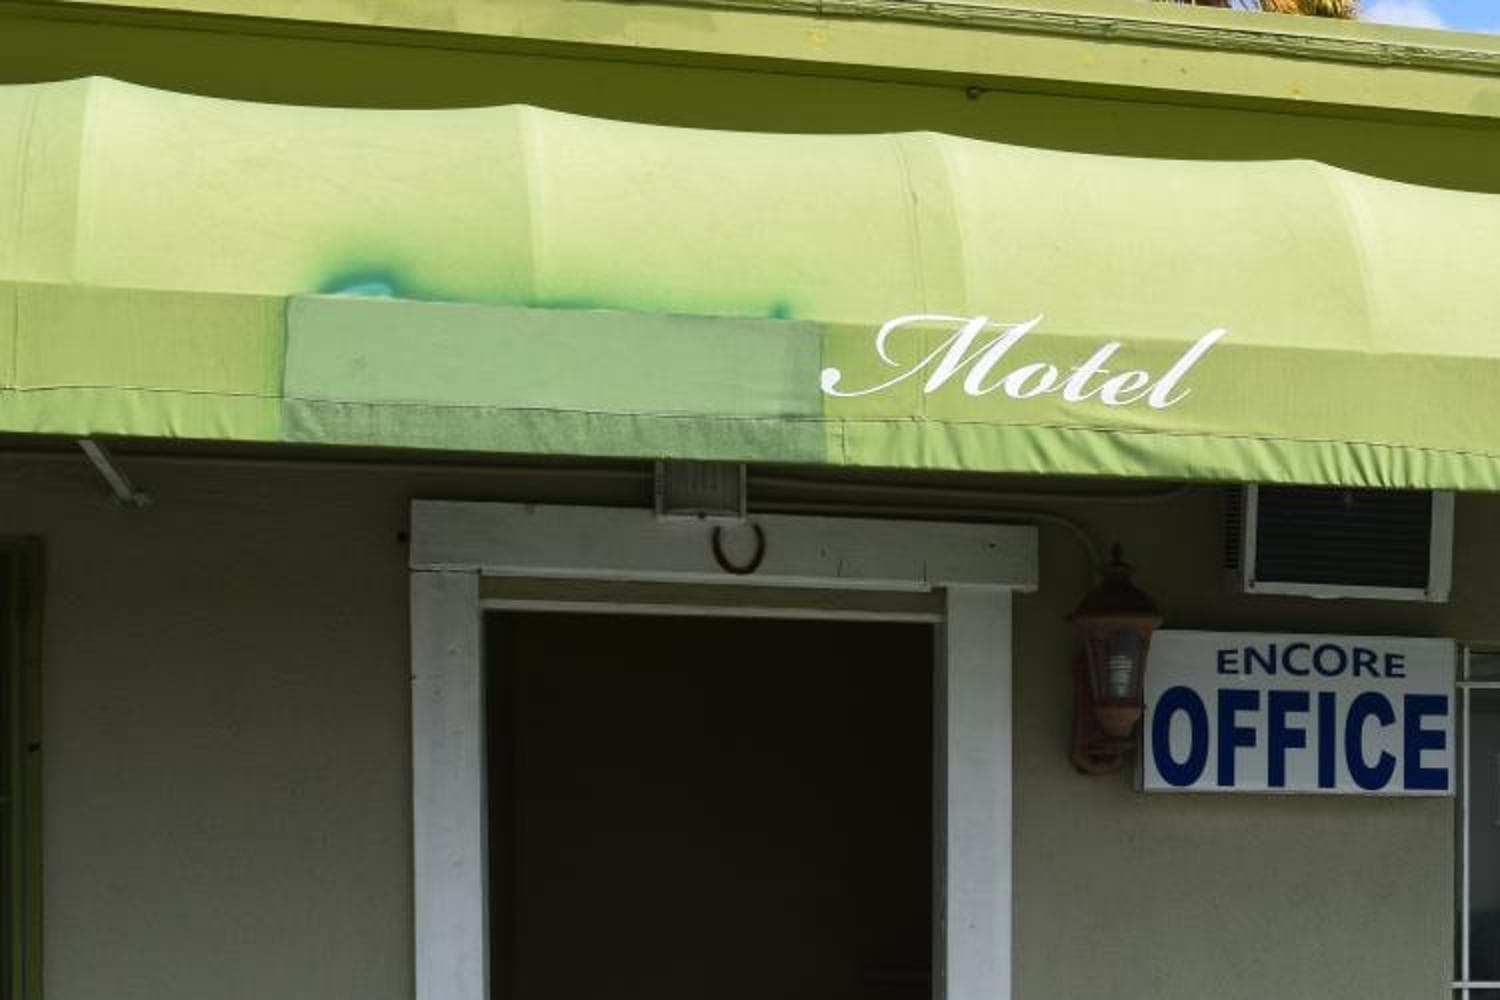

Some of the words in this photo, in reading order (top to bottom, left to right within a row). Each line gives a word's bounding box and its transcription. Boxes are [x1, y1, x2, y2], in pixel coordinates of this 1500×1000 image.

[820, 313, 1227, 408] Motel
[1217, 642, 1406, 678] ENCORE
[1152, 686, 1449, 790] OFFICE
